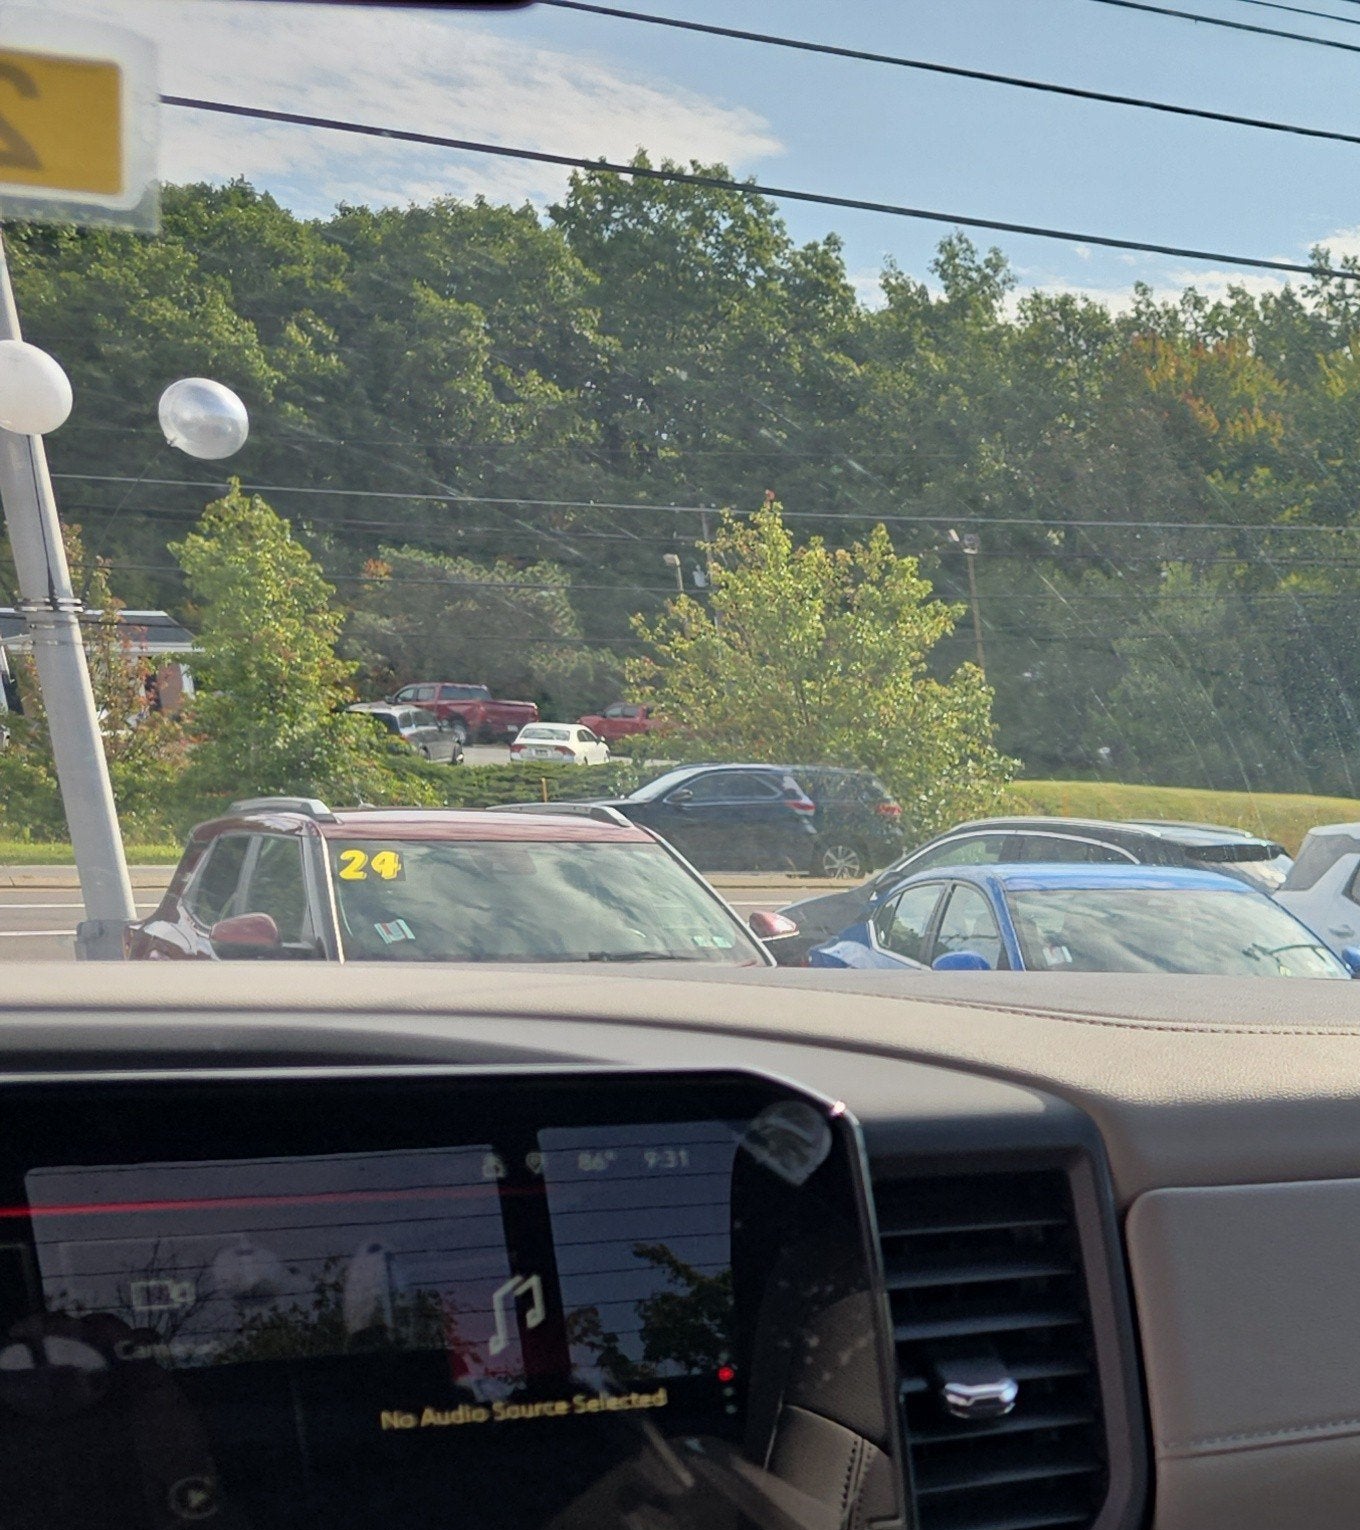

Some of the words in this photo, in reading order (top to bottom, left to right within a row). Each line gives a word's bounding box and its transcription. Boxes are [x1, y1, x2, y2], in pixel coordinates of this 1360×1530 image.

[340, 849, 402, 880] 24
[380, 1410, 418, 1430] No
[420, 1405, 490, 1428] Audio
[491, 1398, 569, 1421] Source
[571, 1387, 669, 1414] Selected
